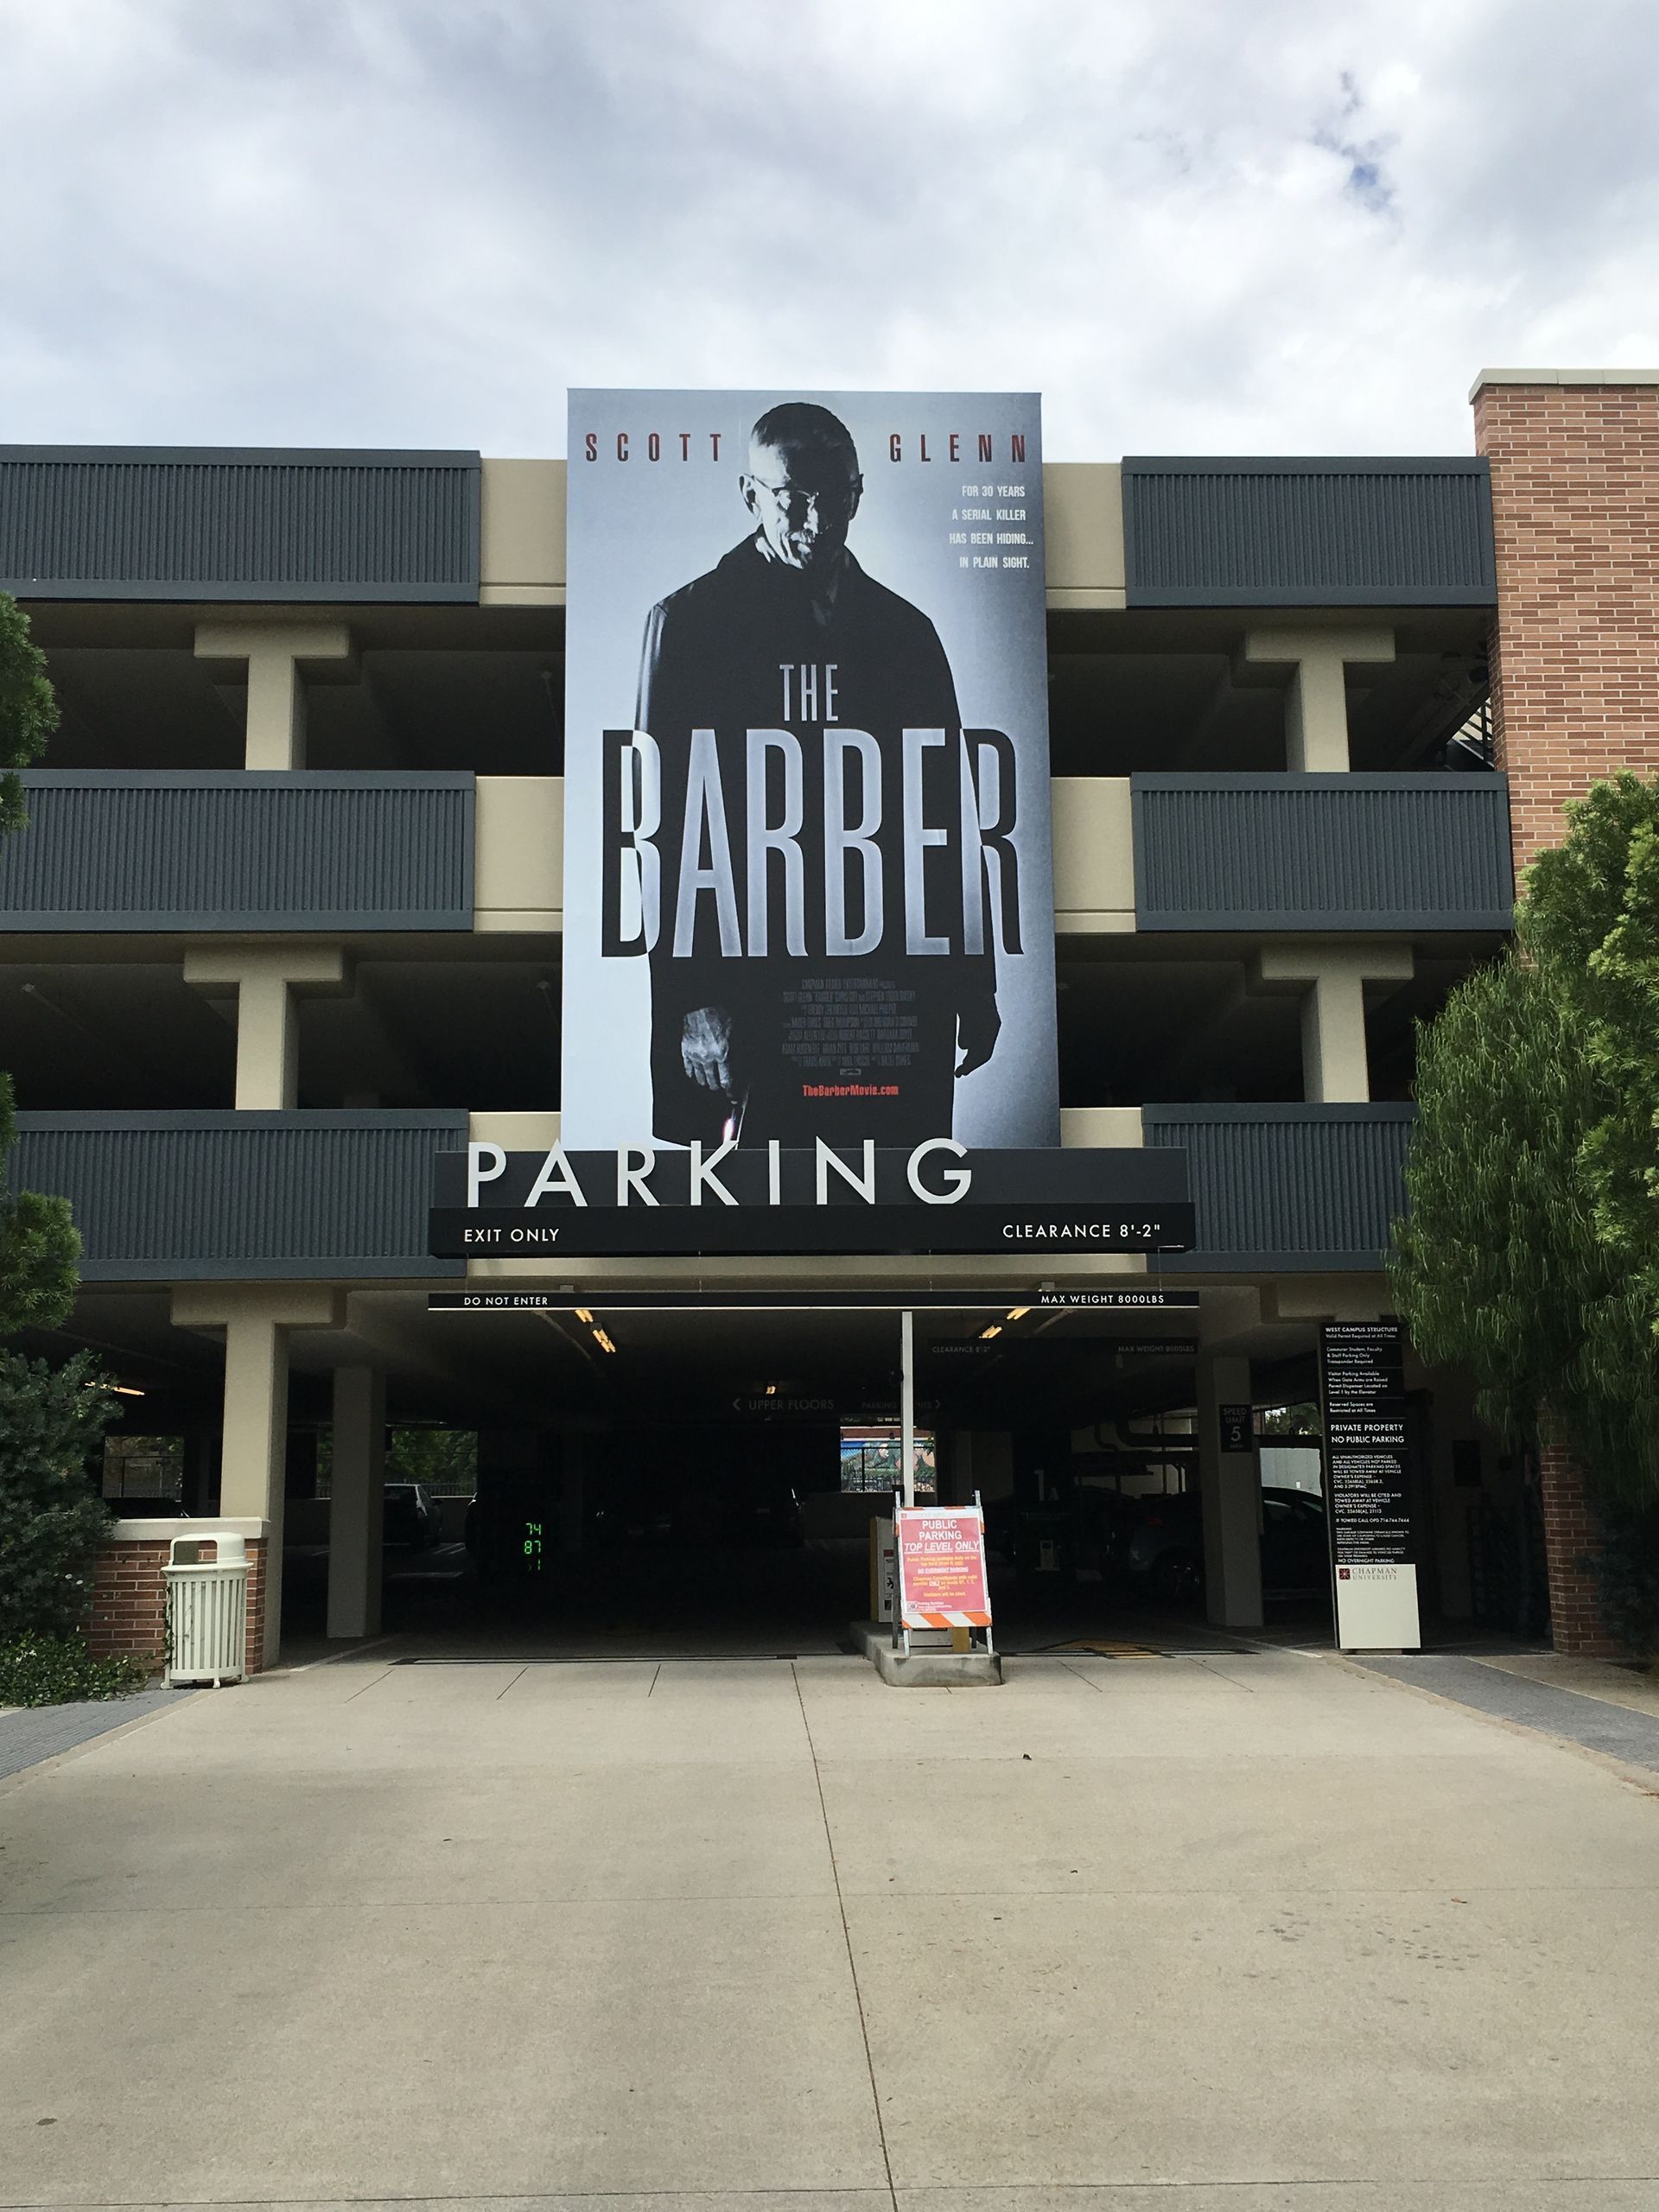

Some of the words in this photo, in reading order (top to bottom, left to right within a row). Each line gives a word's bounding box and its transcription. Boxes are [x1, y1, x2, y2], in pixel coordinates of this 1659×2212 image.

[585, 433, 722, 462] SCOTT
[890, 434, 1026, 463] GLENN
[962, 486, 979, 497] FOR
[982, 486, 993, 498] 30
[997, 486, 1025, 498] YEARS
[951, 510, 958, 520] A
[962, 509, 992, 521] SERIAL
[996, 509, 1026, 521] KILLER
[949, 532, 967, 544] HAS
[970, 532, 993, 544] BEEN
[996, 532, 1033, 544] HIDING...
[959, 556, 969, 569] IN
[973, 556, 998, 569] PLAIN
[1002, 556, 1030, 569] SIGHT.
[779, 664, 838, 721] THE
[601, 728, 1025, 957] BARBER
[803, 1084, 899, 1096] TheBarberMovie.com
[467, 1138, 972, 1208] PARKING
[463, 1229, 501, 1243] EXIT
[510, 1229, 559, 1242] ONLY
[1002, 1224, 1111, 1239] CLEARANCE
[1120, 1224, 1160, 1238] 8'-2"
[463, 1296, 479, 1305] DO
[484, 1296, 510, 1305] NOT
[514, 1296, 548, 1305] ENTER
[1040, 1295, 1065, 1304] MAX
[1069, 1294, 1113, 1304] WEIGHT
[1117, 1294, 1165, 1304] 8000LBS
[748, 1400, 783, 1410] UPPER
[789, 1399, 834, 1410] FLOORS
[1230, 1426, 1241, 1441] 5
[525, 1522, 542, 1535] 74
[922, 1520, 957, 1529] PUBLIC
[919, 1531, 962, 1540] PARKING
[524, 1540, 542, 1554] 87
[905, 1542, 922, 1551] TOP
[925, 1542, 953, 1551] LEVEL
[955, 1541, 979, 1550] ONLY
